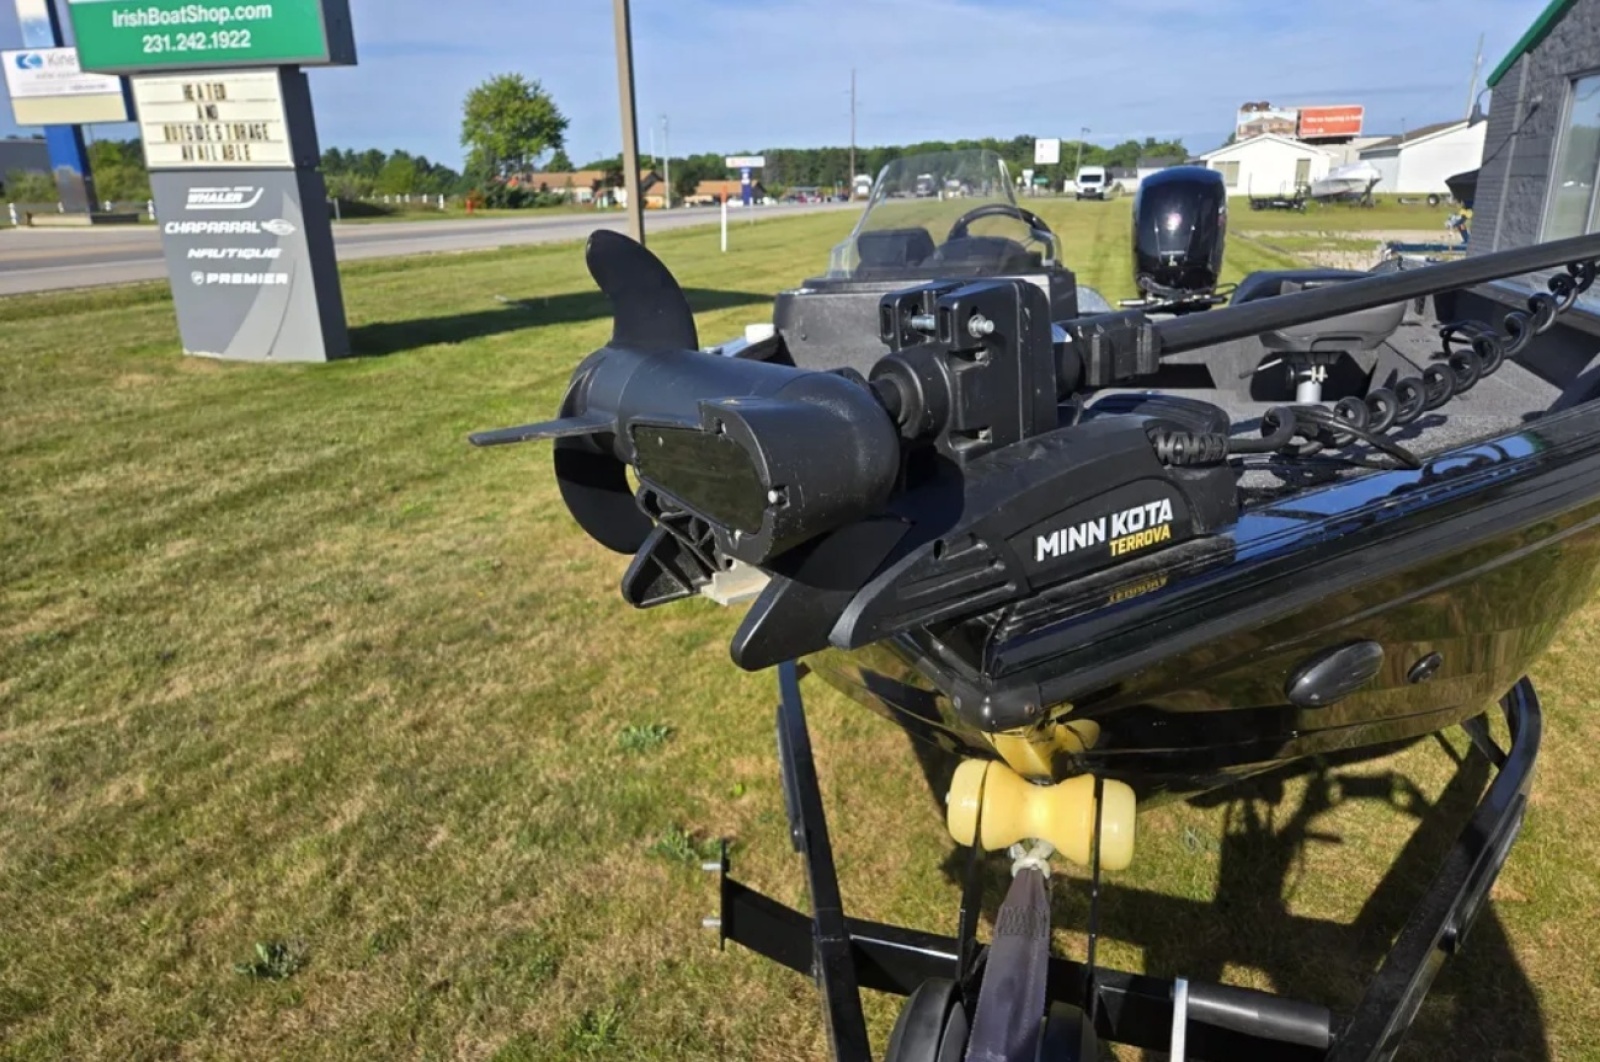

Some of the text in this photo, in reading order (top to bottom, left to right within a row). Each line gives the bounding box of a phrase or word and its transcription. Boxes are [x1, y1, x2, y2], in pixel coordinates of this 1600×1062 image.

[112, 4, 272, 27] IrishBoatShop.com
[143, 29, 252, 53] 231.242.1922
[182, 83, 227, 102] HEATED
[197, 104, 219, 120] AND
[163, 122, 269, 142] OUTSIDE STORAGE
[181, 143, 251, 162] AVAILABLE
[165, 221, 262, 234] CHAPARRAL
[187, 248, 283, 260] NAUTIQUE
[206, 272, 289, 285] PREMIER
[1036, 498, 1174, 562] MINN KOTA
[1109, 523, 1172, 557] TERROVA
